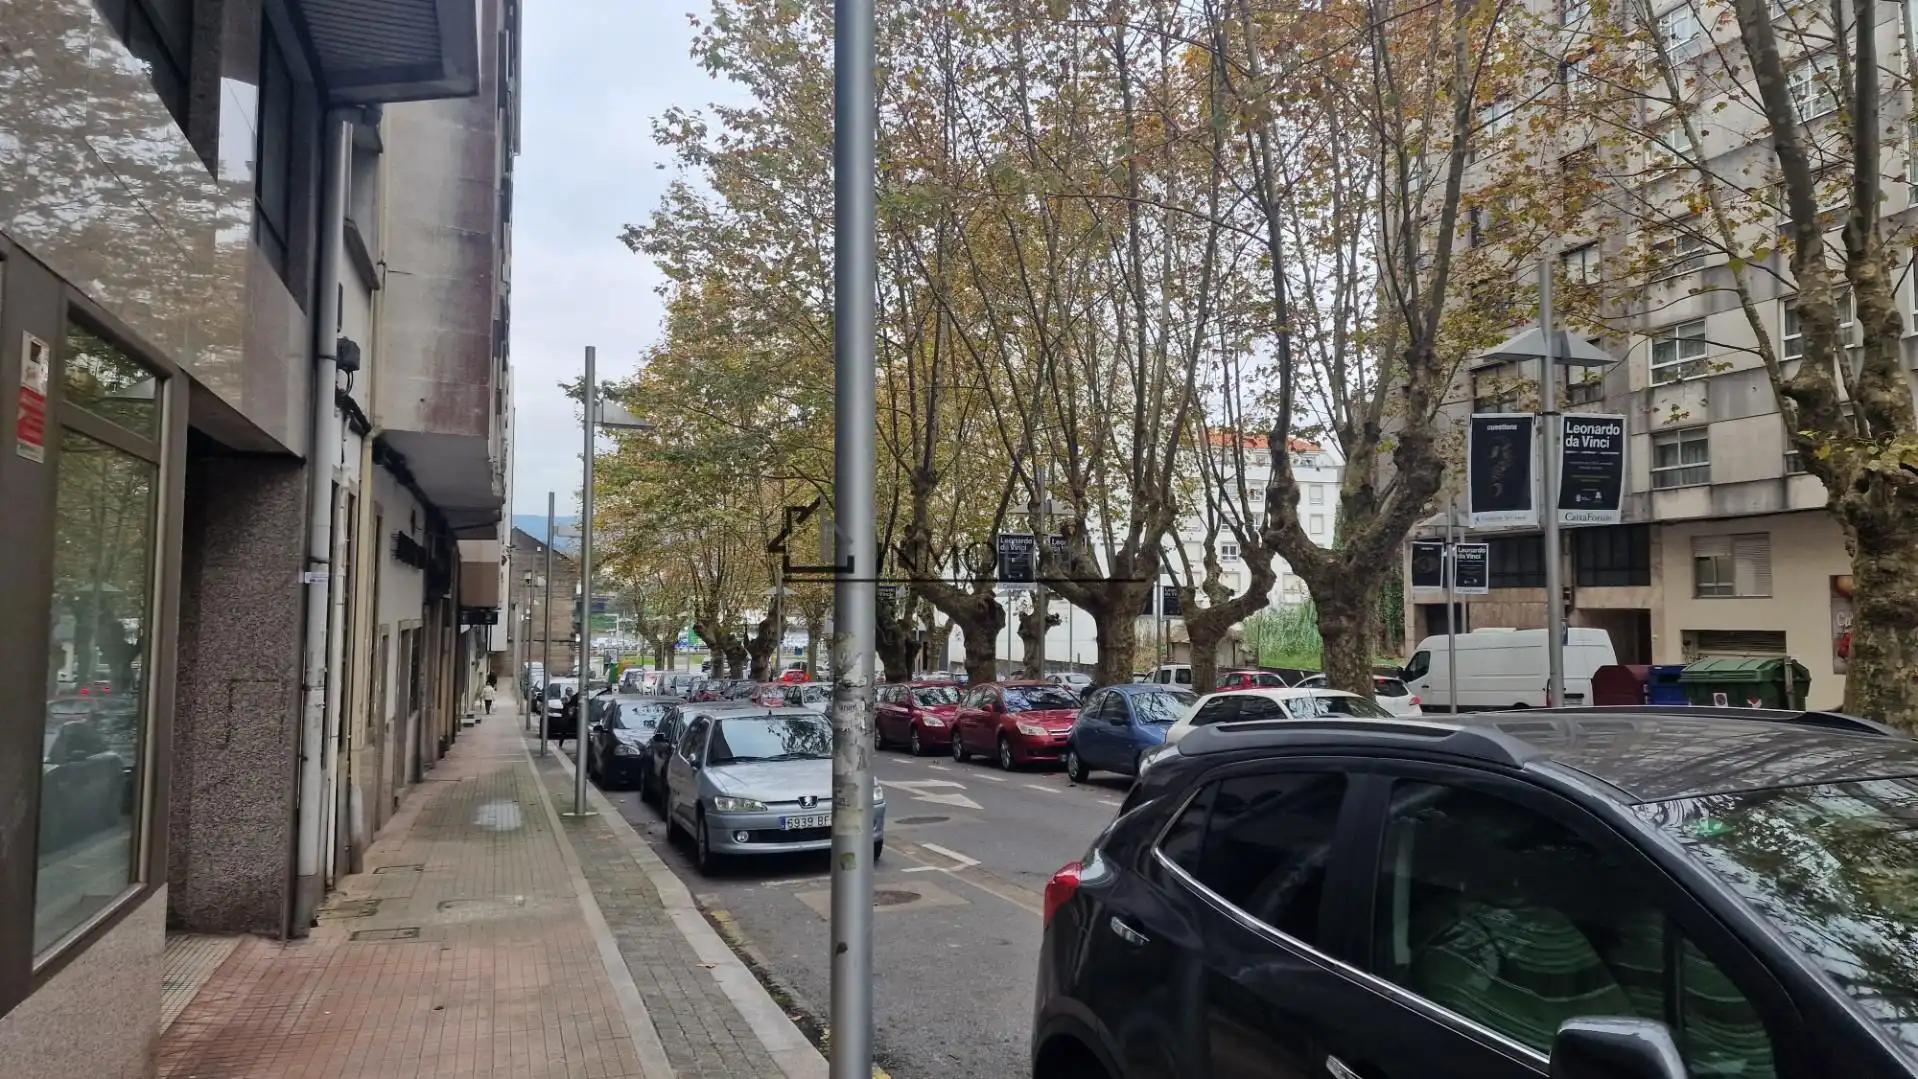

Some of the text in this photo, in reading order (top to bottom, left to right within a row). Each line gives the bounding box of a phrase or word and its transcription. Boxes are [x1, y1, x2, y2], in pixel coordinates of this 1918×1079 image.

[1566, 421, 1621, 436] Leonardo
[1565, 435, 1610, 449] da Vinci
[787, 817, 814, 828] 6939
